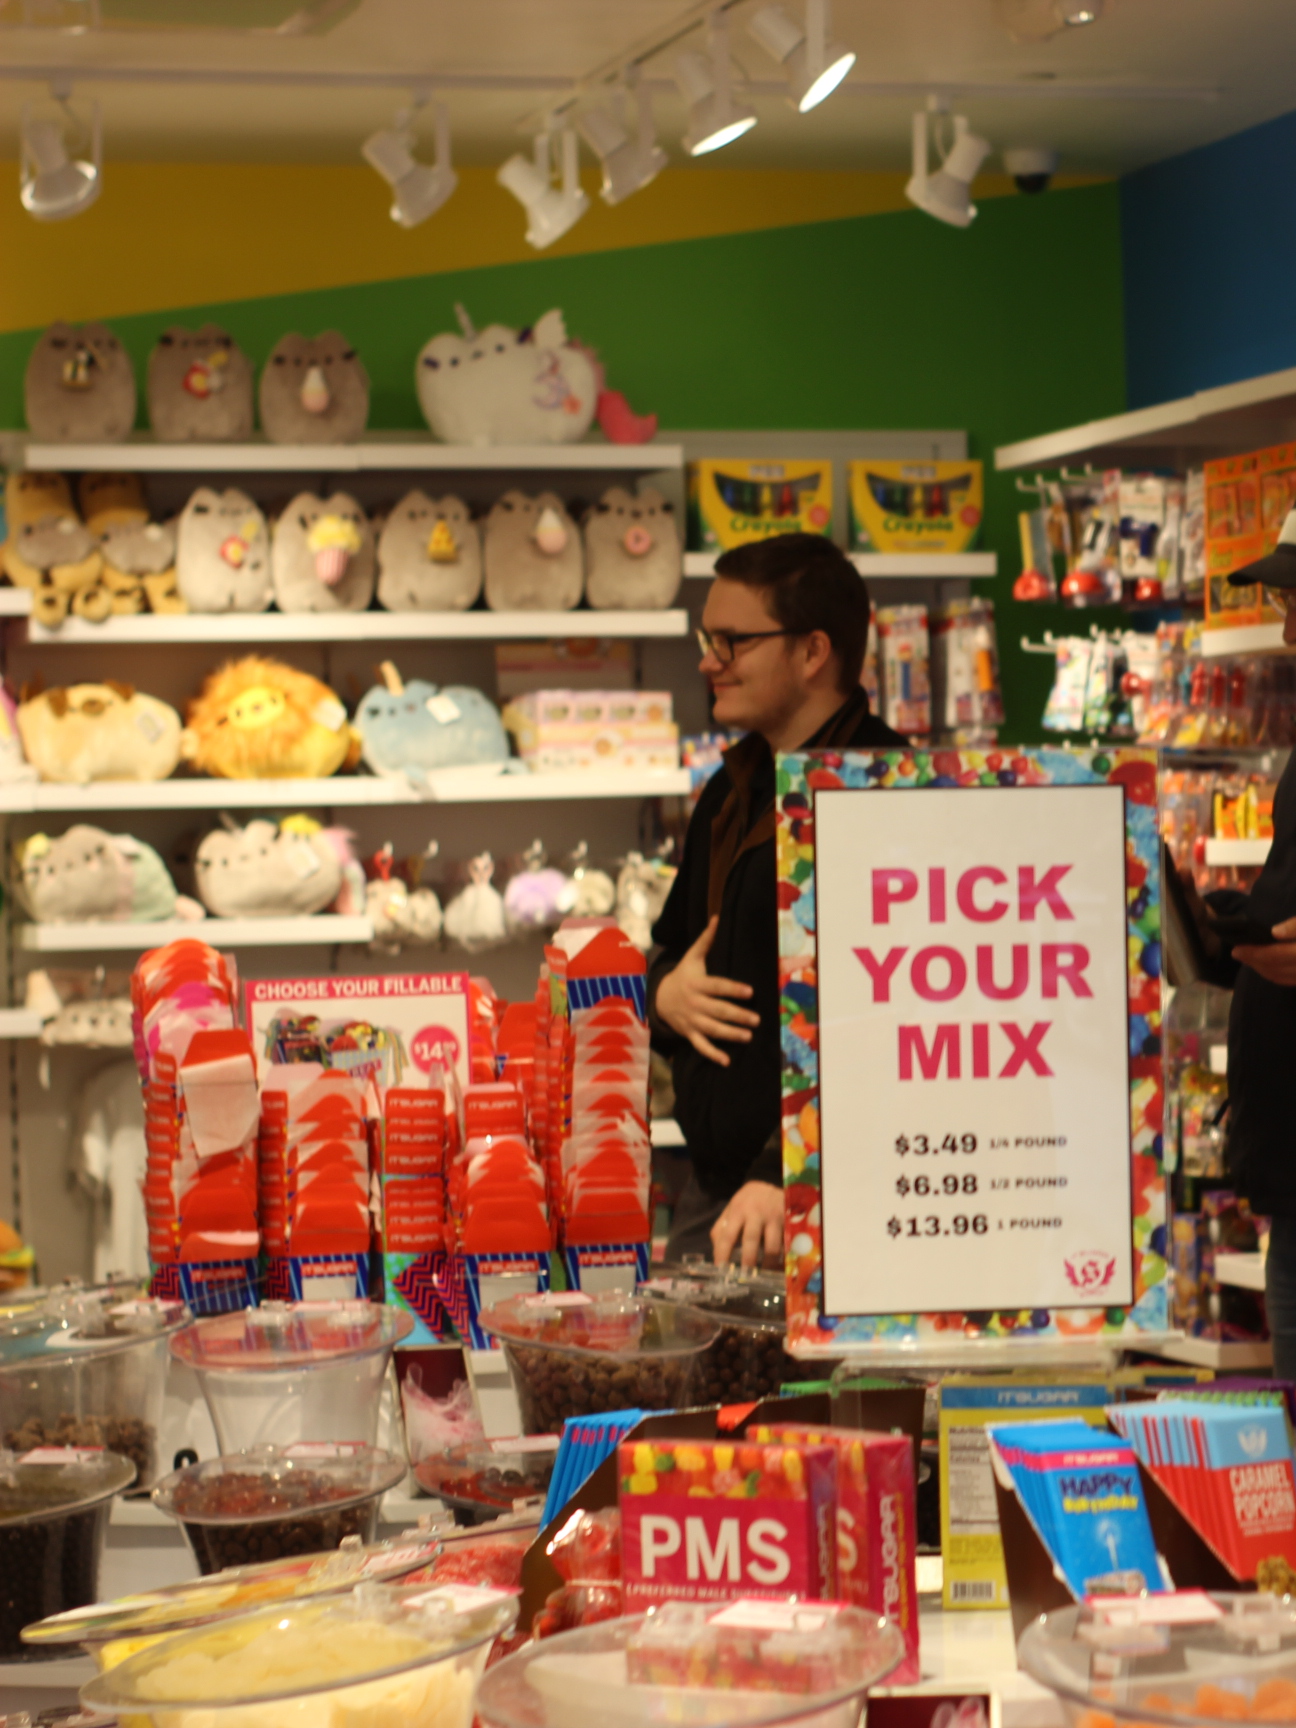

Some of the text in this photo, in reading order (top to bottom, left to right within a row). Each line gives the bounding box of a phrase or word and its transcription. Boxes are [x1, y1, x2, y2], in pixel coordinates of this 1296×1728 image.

[730, 517, 801, 534] Crayola
[884, 516, 954, 535] Crayola
[871, 864, 1075, 924] PICK
[851, 942, 1094, 1003] YOUR
[254, 975, 462, 1000] CHOOSE YOUR FILLABLE
[897, 1021, 1055, 1080] MIX
[894, 1133, 978, 1156] $3.49
[1015, 1135, 1067, 1148] POUND
[896, 1174, 1068, 1197] $6.98 1/2 POUND
[886, 1214, 989, 1238] $13.96
[1009, 1217, 1063, 1230] POUND
[1060, 1473, 1132, 1497] HAPPY
[1229, 1463, 1290, 1494] CARAMEL
[1233, 1490, 1296, 1520] POPCORN
[640, 1514, 791, 1585] PMS
